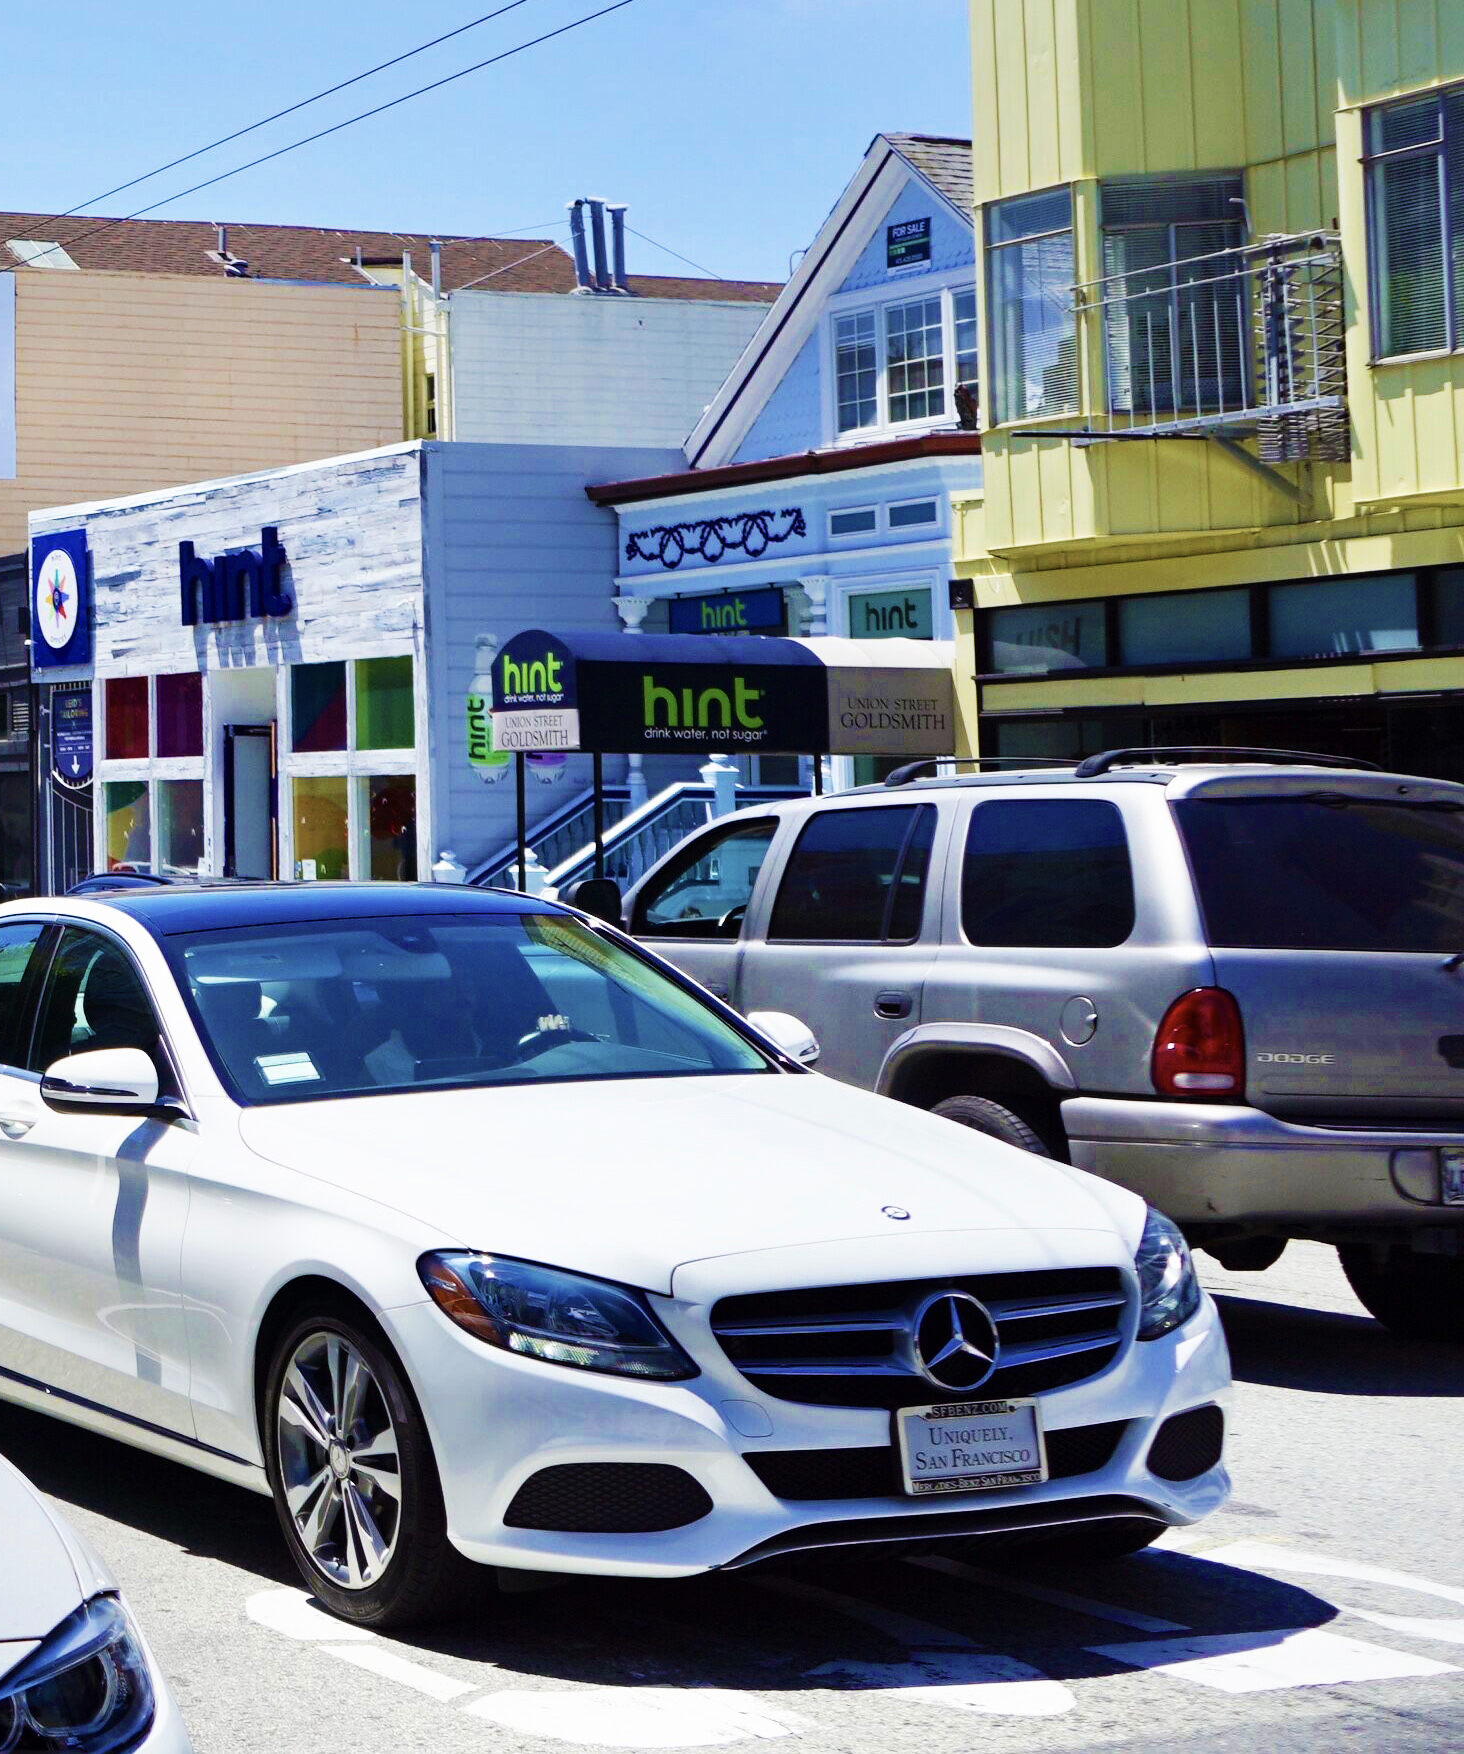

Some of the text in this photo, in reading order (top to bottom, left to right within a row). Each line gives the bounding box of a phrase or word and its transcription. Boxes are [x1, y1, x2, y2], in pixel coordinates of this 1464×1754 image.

[892, 226, 906, 238] FOR
[907, 221, 926, 235] SALE
[179, 526, 293, 626] hint
[701, 598, 748, 629] hint
[864, 597, 918, 632] hint
[503, 651, 564, 695] hint
[642, 675, 765, 729] hint
[847, 697, 940, 711] UNION STREET
[467, 697, 487, 761] hint
[504, 714, 564, 728] UNION STREET
[840, 711, 946, 731] GOLDSMITH
[501, 729, 569, 748] GOLDSMITH
[644, 727, 672, 740] drink
[711, 728, 731, 740] not
[732, 729, 764, 743] sugar
[1256, 1052, 1336, 1065] DODGE
[931, 1400, 1008, 1419] SFBENZ.COM
